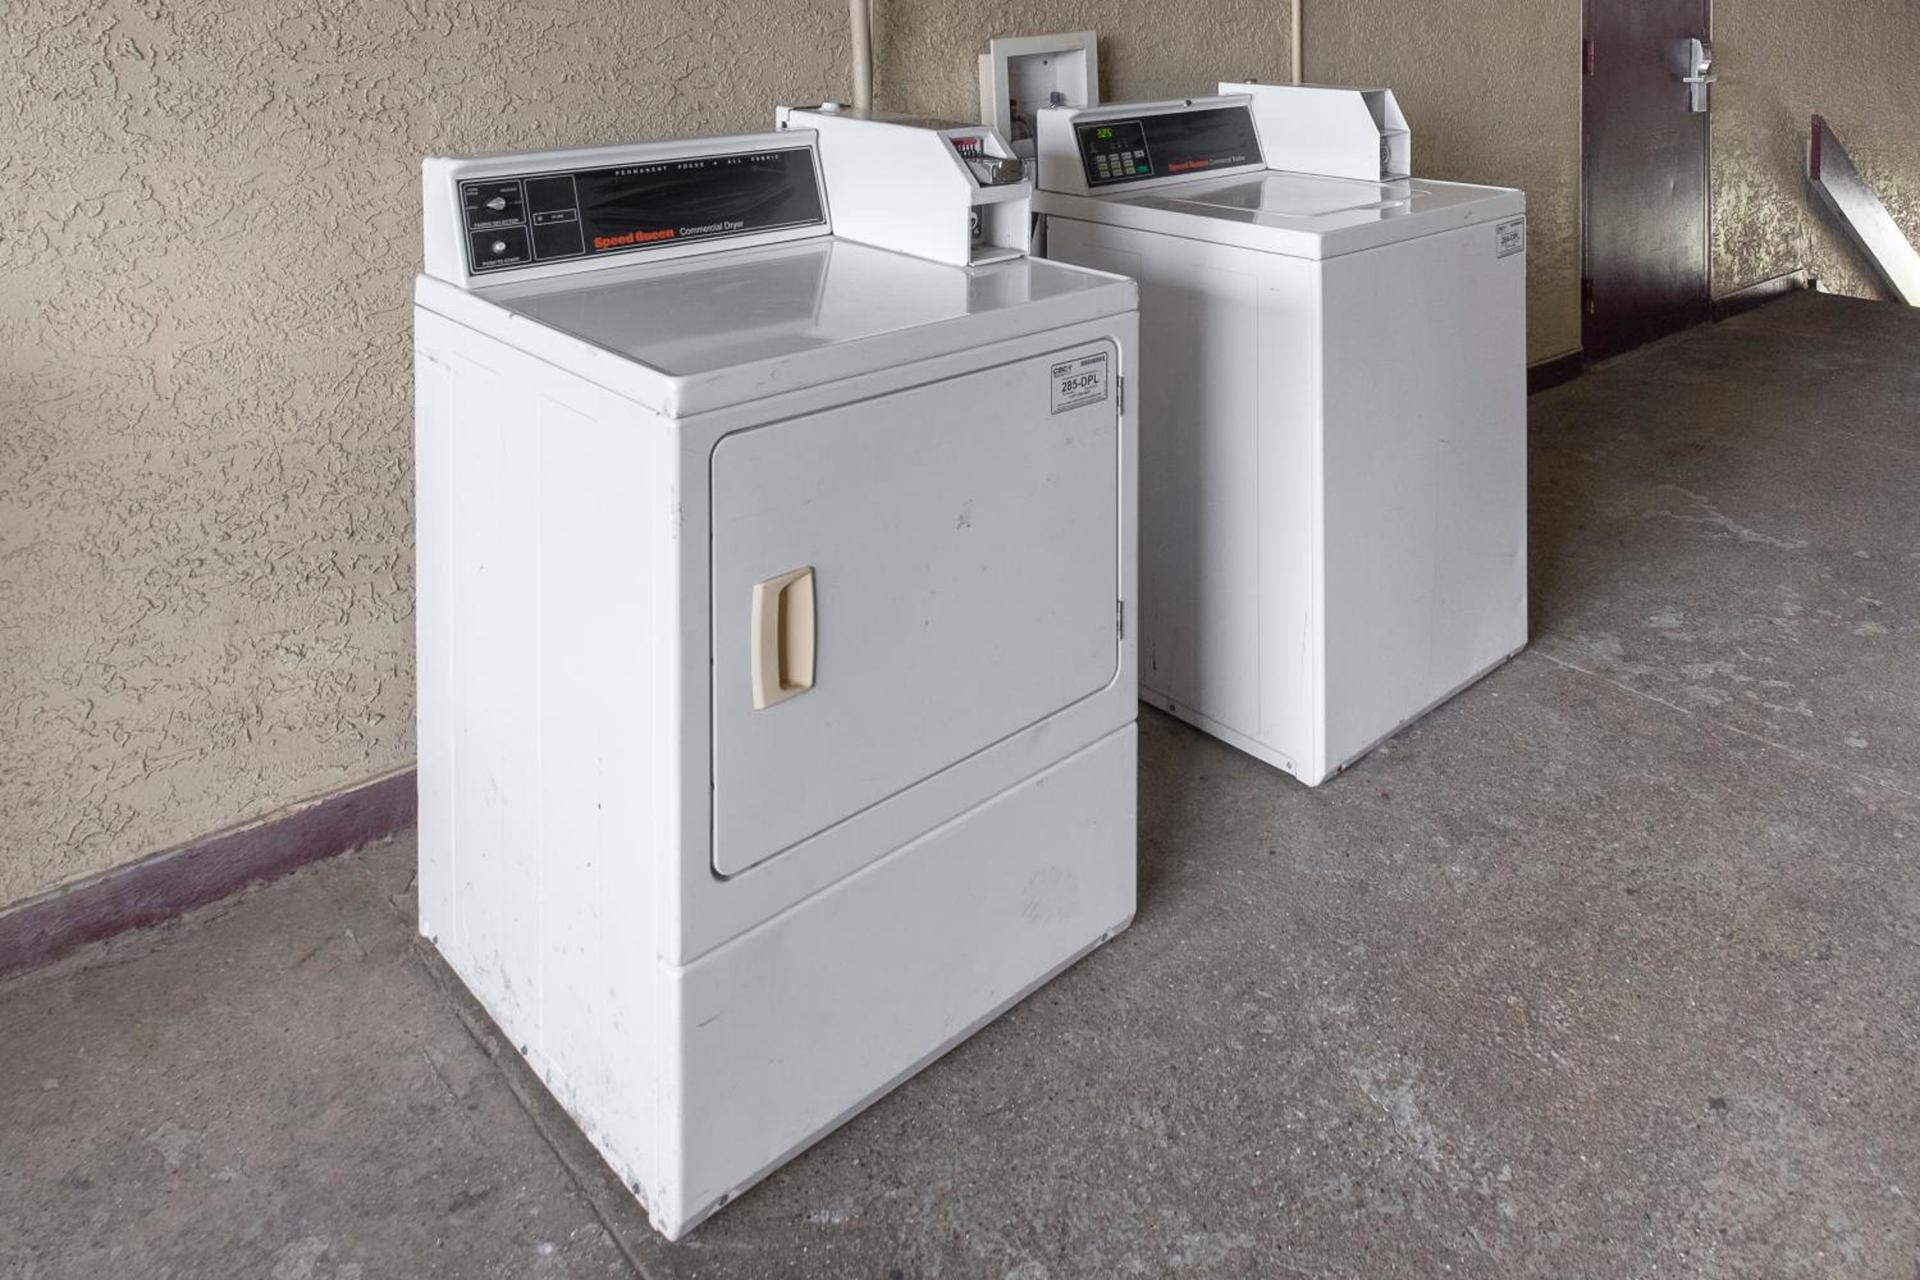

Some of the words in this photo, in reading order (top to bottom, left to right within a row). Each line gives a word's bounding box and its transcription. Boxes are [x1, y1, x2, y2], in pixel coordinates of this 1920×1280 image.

[593, 232, 634, 248] Speed
[635, 228, 674, 242] Queen
[679, 222, 722, 236] Commercial
[723, 220, 744, 232] Dryer
[1062, 374, 1099, 392] 285-DPL
